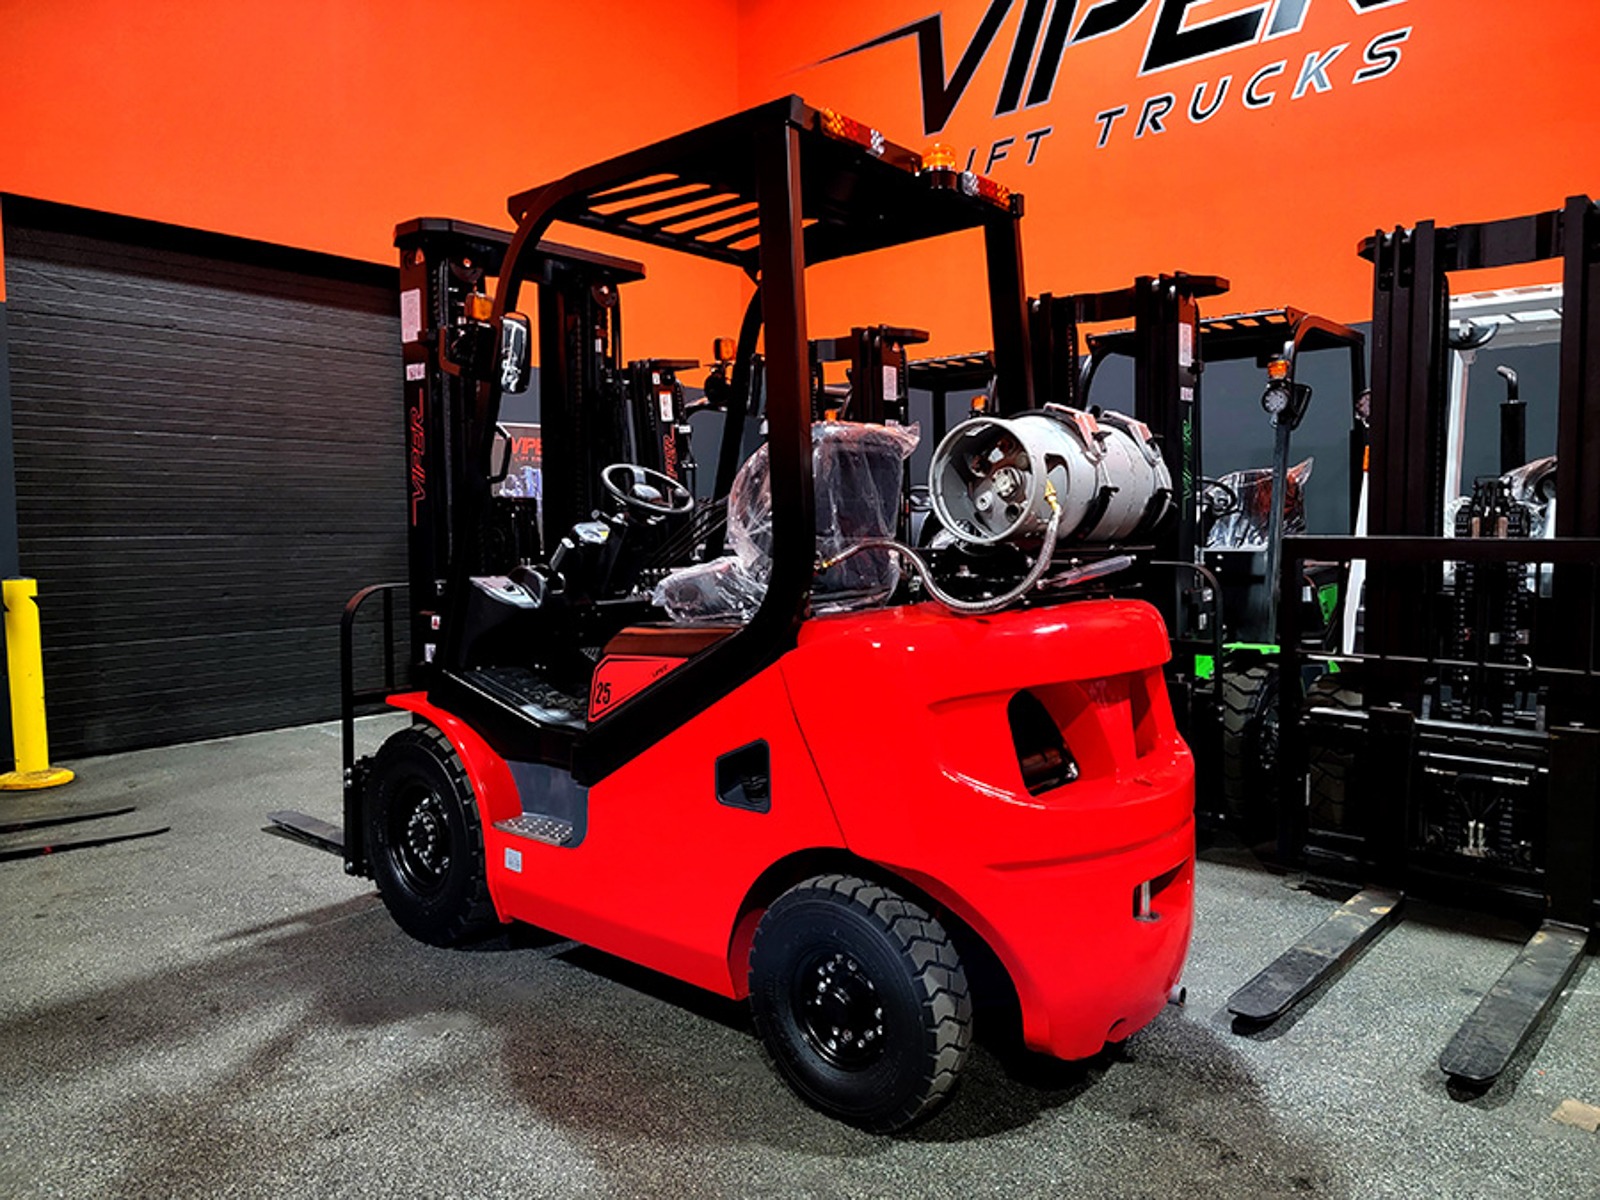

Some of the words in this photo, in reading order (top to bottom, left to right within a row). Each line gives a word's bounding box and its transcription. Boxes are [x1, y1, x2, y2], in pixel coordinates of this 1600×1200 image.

[795, 0, 1420, 137] VIP
[964, 125, 1053, 176] IFT
[1096, 27, 1412, 148] TRUCKS
[511, 436, 542, 456] VIPE
[596, 682, 611, 705] 25
